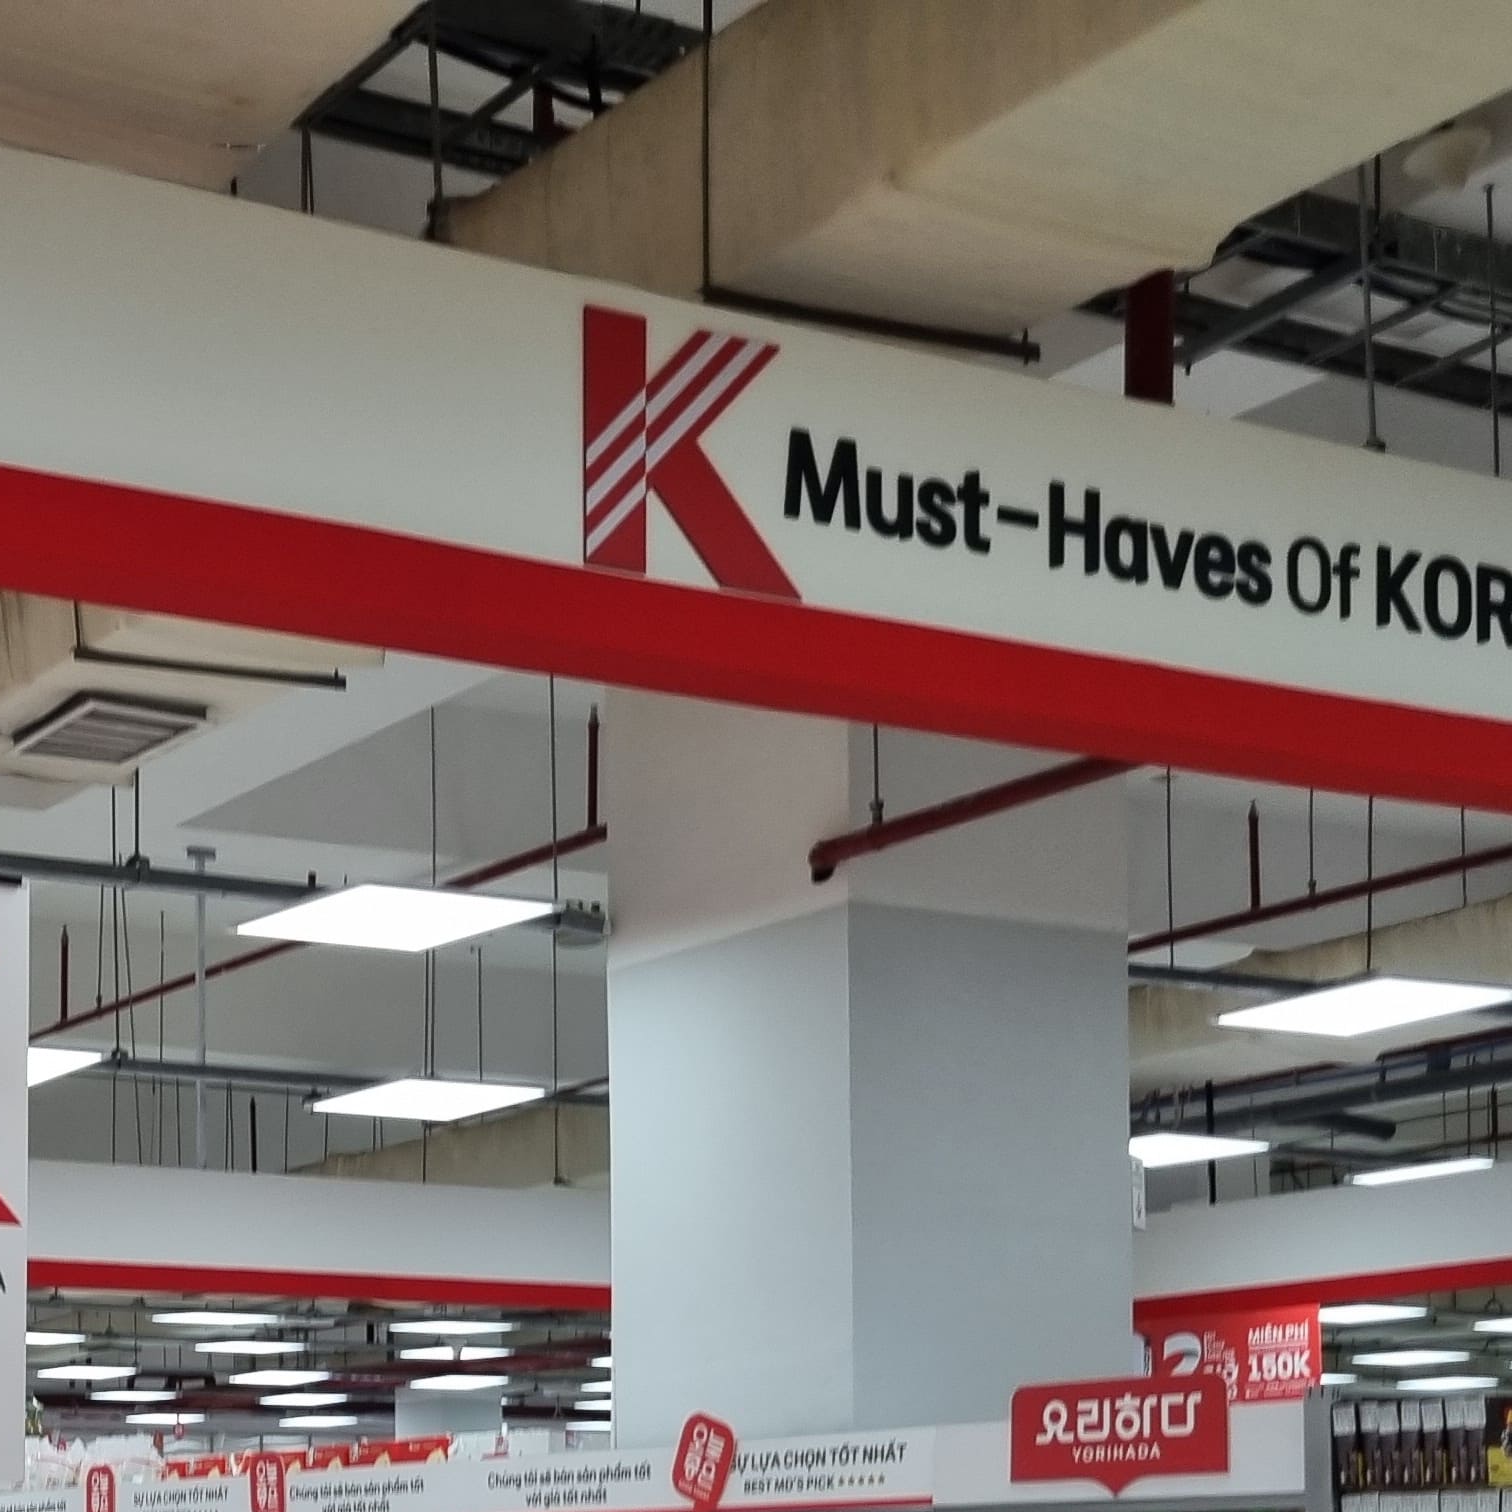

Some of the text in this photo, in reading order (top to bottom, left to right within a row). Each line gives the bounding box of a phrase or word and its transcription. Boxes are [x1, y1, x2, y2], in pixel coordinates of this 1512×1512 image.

[783, 426, 1273, 606] Must-Haves
[1286, 536, 1361, 620] Of
[1035, 1391, 1203, 1447] 요리하다
[751, 1449, 781, 1473] LỰA
[784, 1447, 827, 1474] CHỌN
[829, 1441, 860, 1466] TỐT
[862, 1437, 908, 1465] NHẤT
[1072, 1445, 1161, 1463] YORIHADA
[488, 1468, 522, 1490] Chúng
[524, 1466, 538, 1487] tôi
[599, 1463, 632, 1487] phẩm
[579, 1485, 608, 1505] nhất
